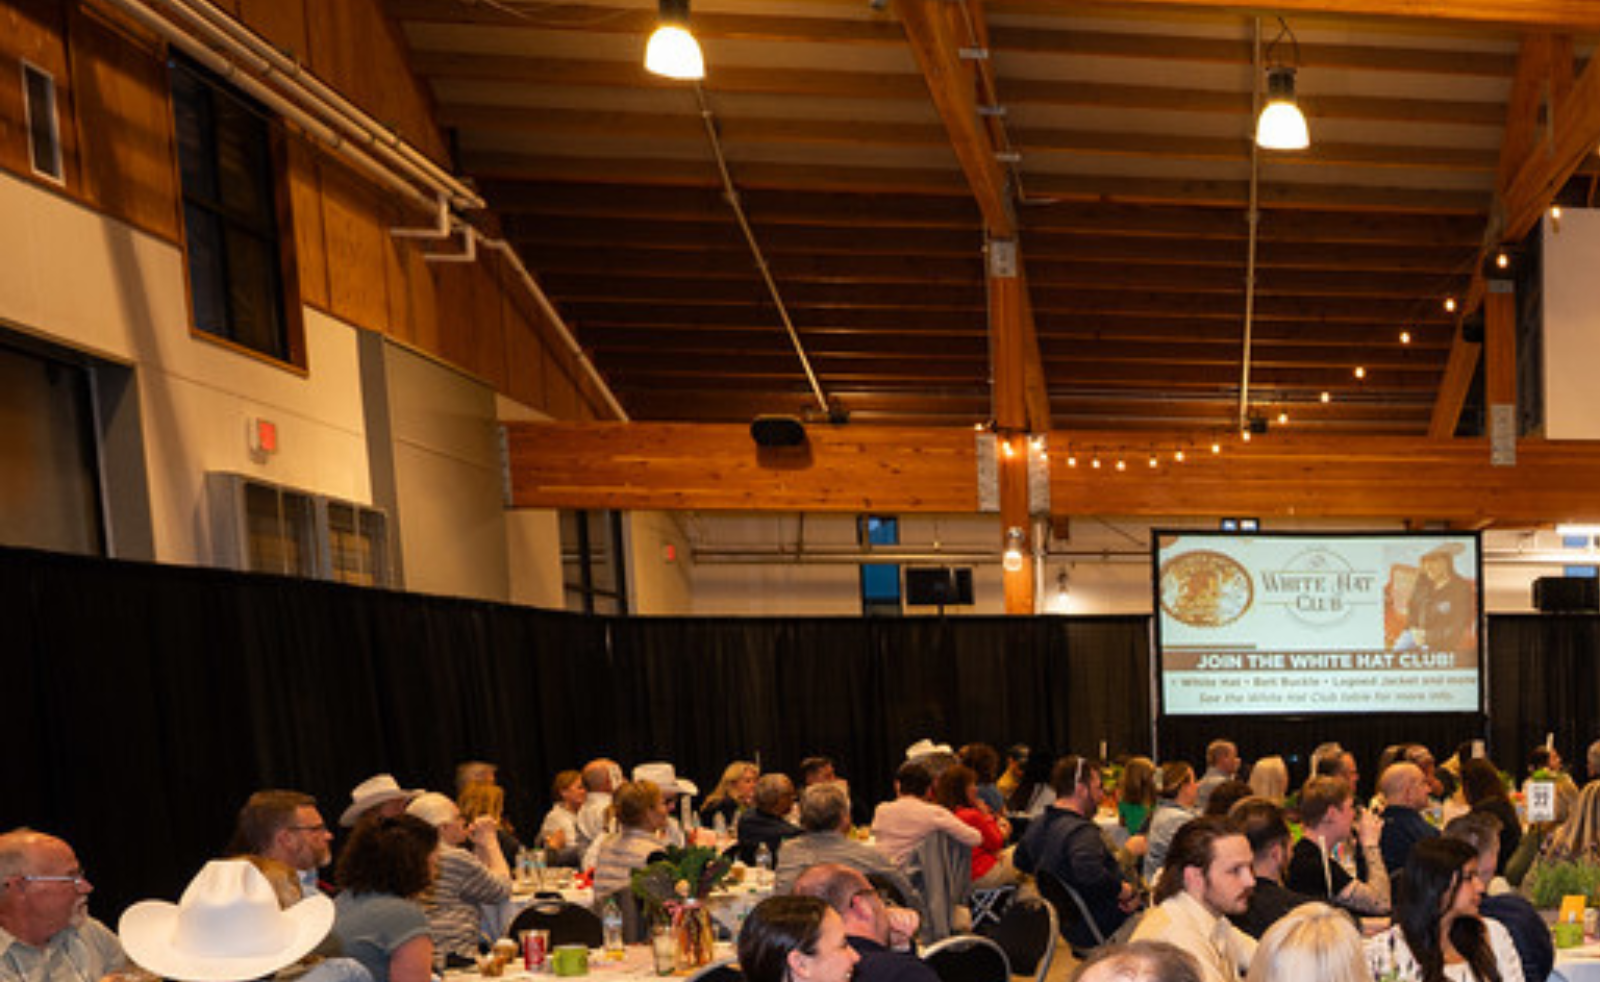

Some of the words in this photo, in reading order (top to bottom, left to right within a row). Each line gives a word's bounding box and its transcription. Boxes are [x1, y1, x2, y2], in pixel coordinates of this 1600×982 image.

[1197, 654, 1242, 669] JOIN
[1247, 654, 1285, 669] THE
[1289, 653, 1352, 669] WHITE
[1355, 653, 1394, 669] HAT
[1398, 651, 1455, 668] CLUB!
